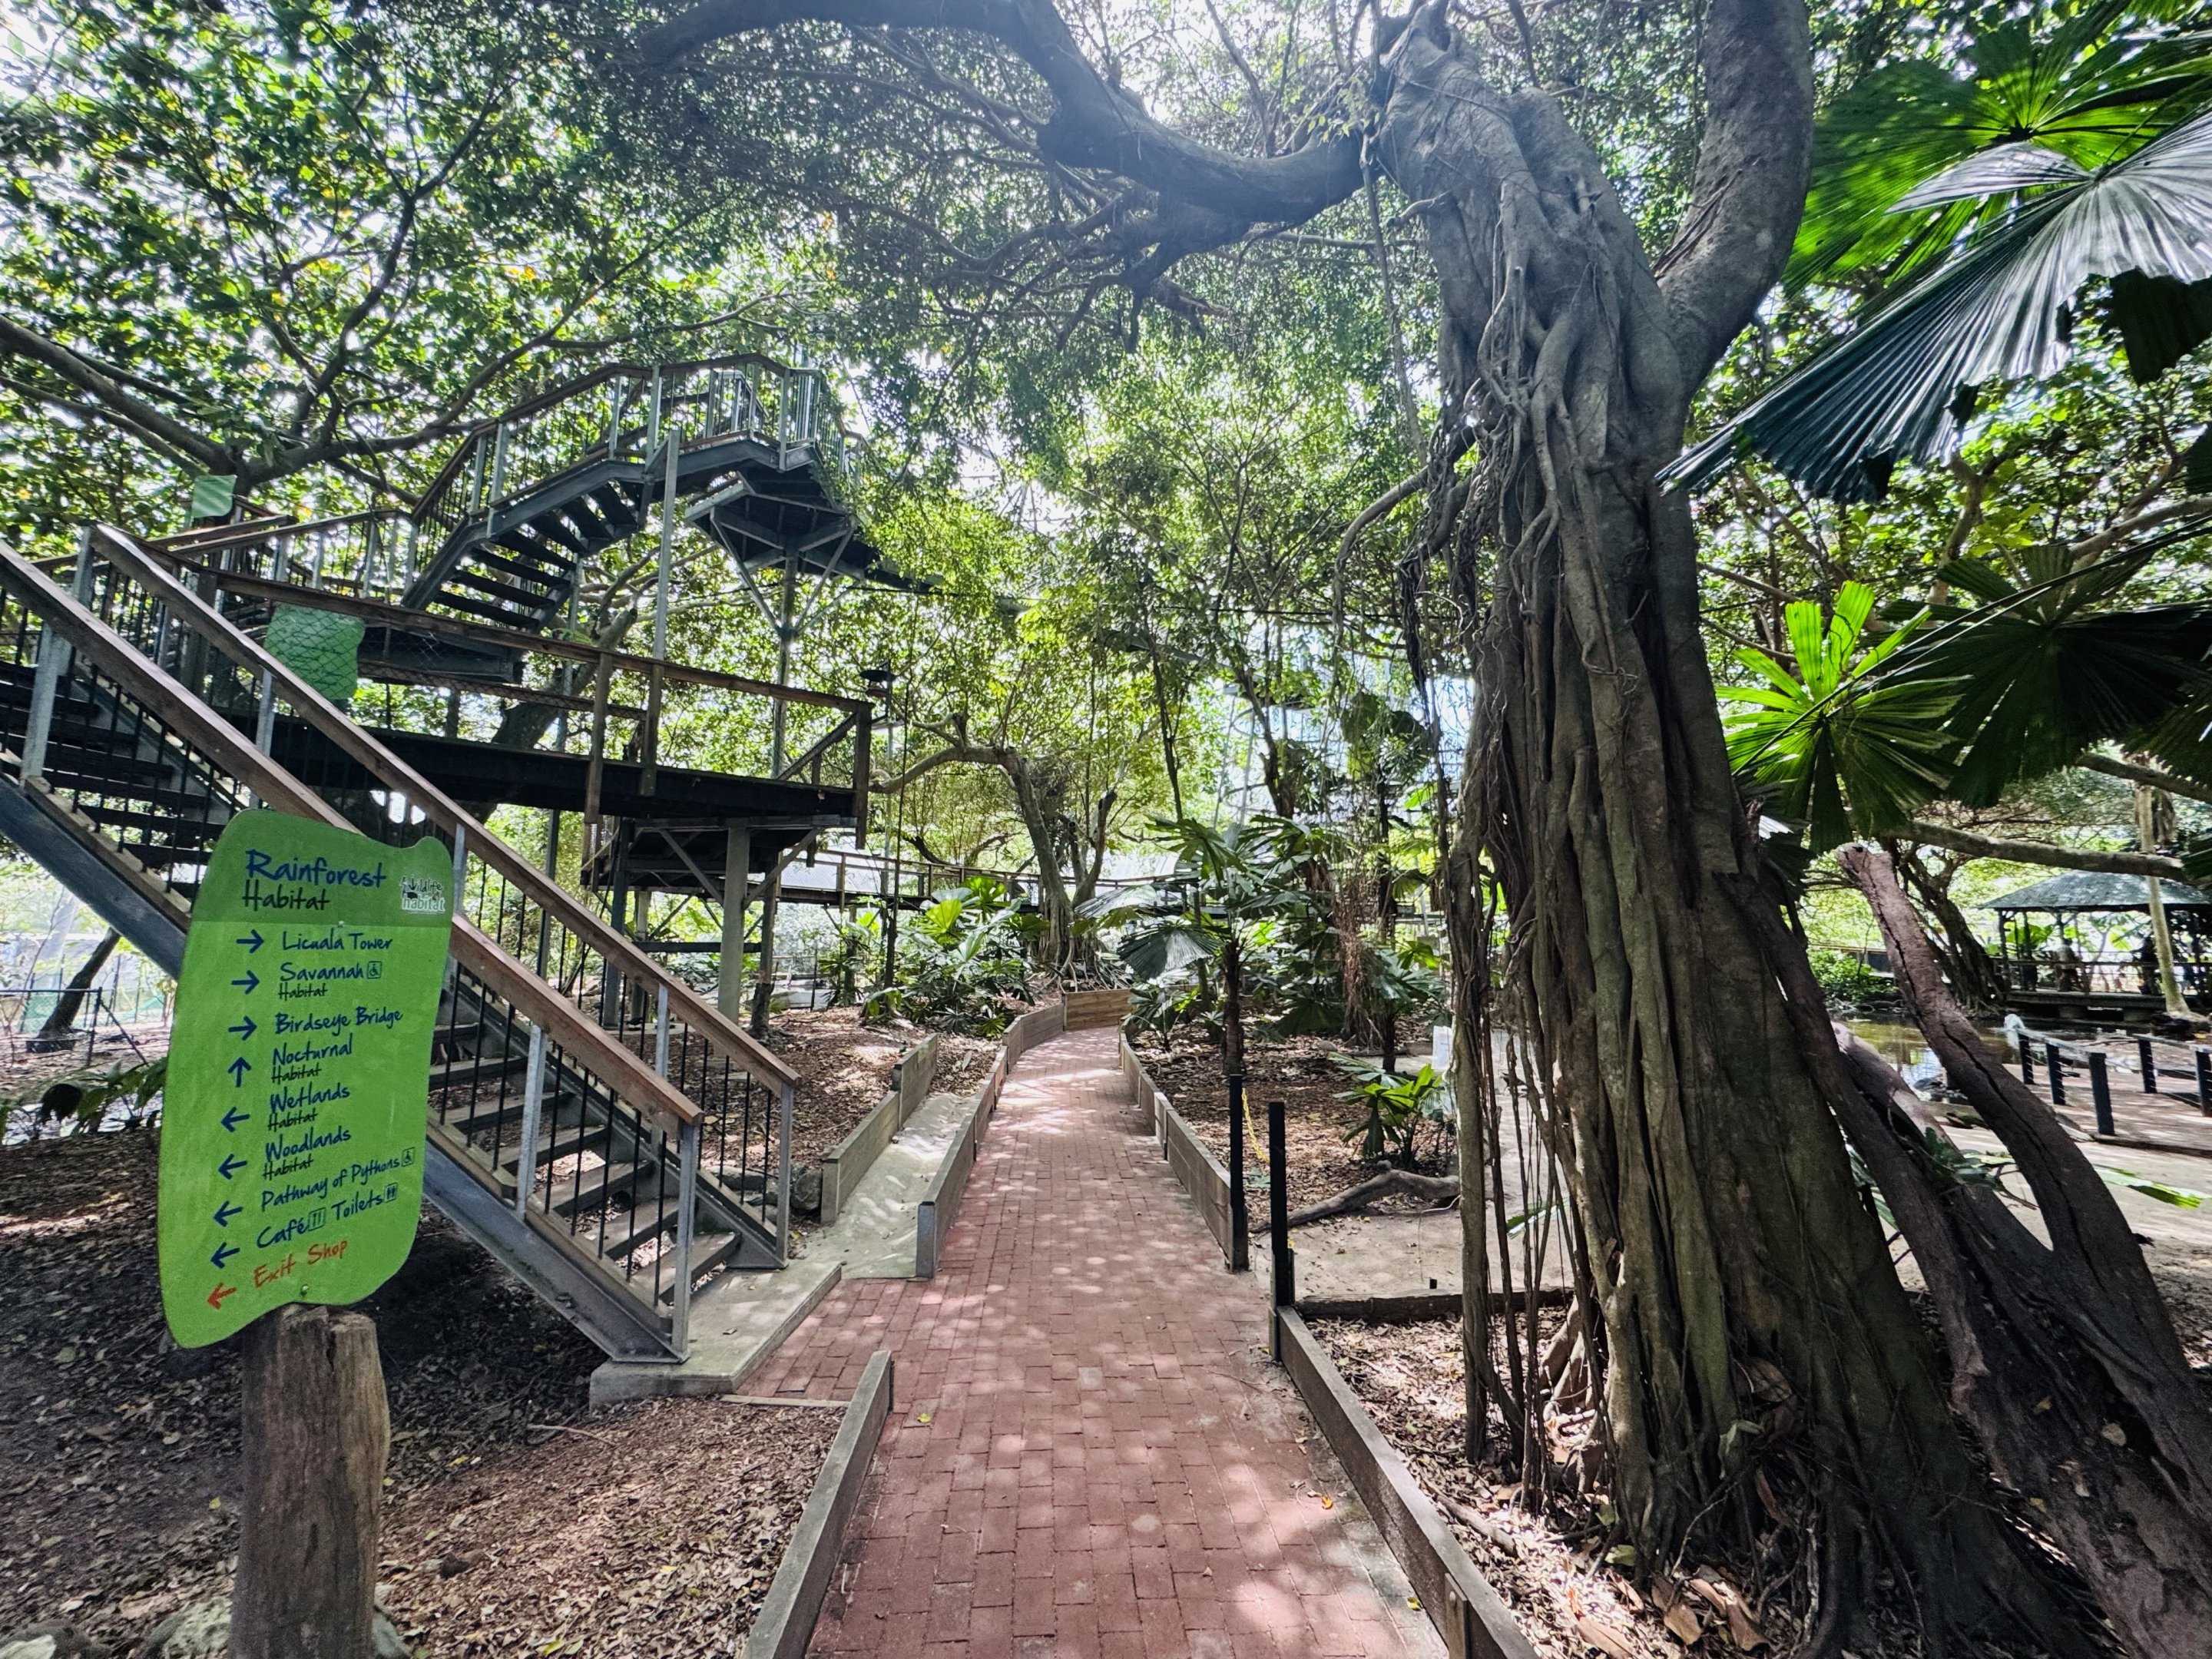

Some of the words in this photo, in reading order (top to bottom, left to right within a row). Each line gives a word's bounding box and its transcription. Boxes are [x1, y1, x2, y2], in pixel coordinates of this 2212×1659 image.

[246, 849, 387, 888] Rainforest
[242, 879, 330, 911] Habitat
[402, 895, 445, 912] habitat
[282, 929, 343, 952] Licuala
[349, 933, 393, 951] Tower
[280, 962, 363, 983] Savannah
[278, 983, 329, 1001] Habitat
[275, 1012, 351, 1036] Birdseye
[355, 1006, 403, 1029] Bridge
[273, 1032, 353, 1065] Nocturnal
[271, 1062, 322, 1084] Habitat
[270, 1082, 350, 1113] Wetlands
[267, 1108, 319, 1132] Habitat
[265, 1124, 351, 1162] Woodlands
[263, 1154, 313, 1181] Habitat
[261, 1176, 328, 1212] Pathway
[333, 1170, 347, 1188] of
[350, 1157, 400, 1186] Pythons
[257, 1217, 308, 1249] Café
[331, 1190, 383, 1220] Toilets
[253, 1253, 296, 1289] Exit
[306, 1239, 348, 1264] Shop
